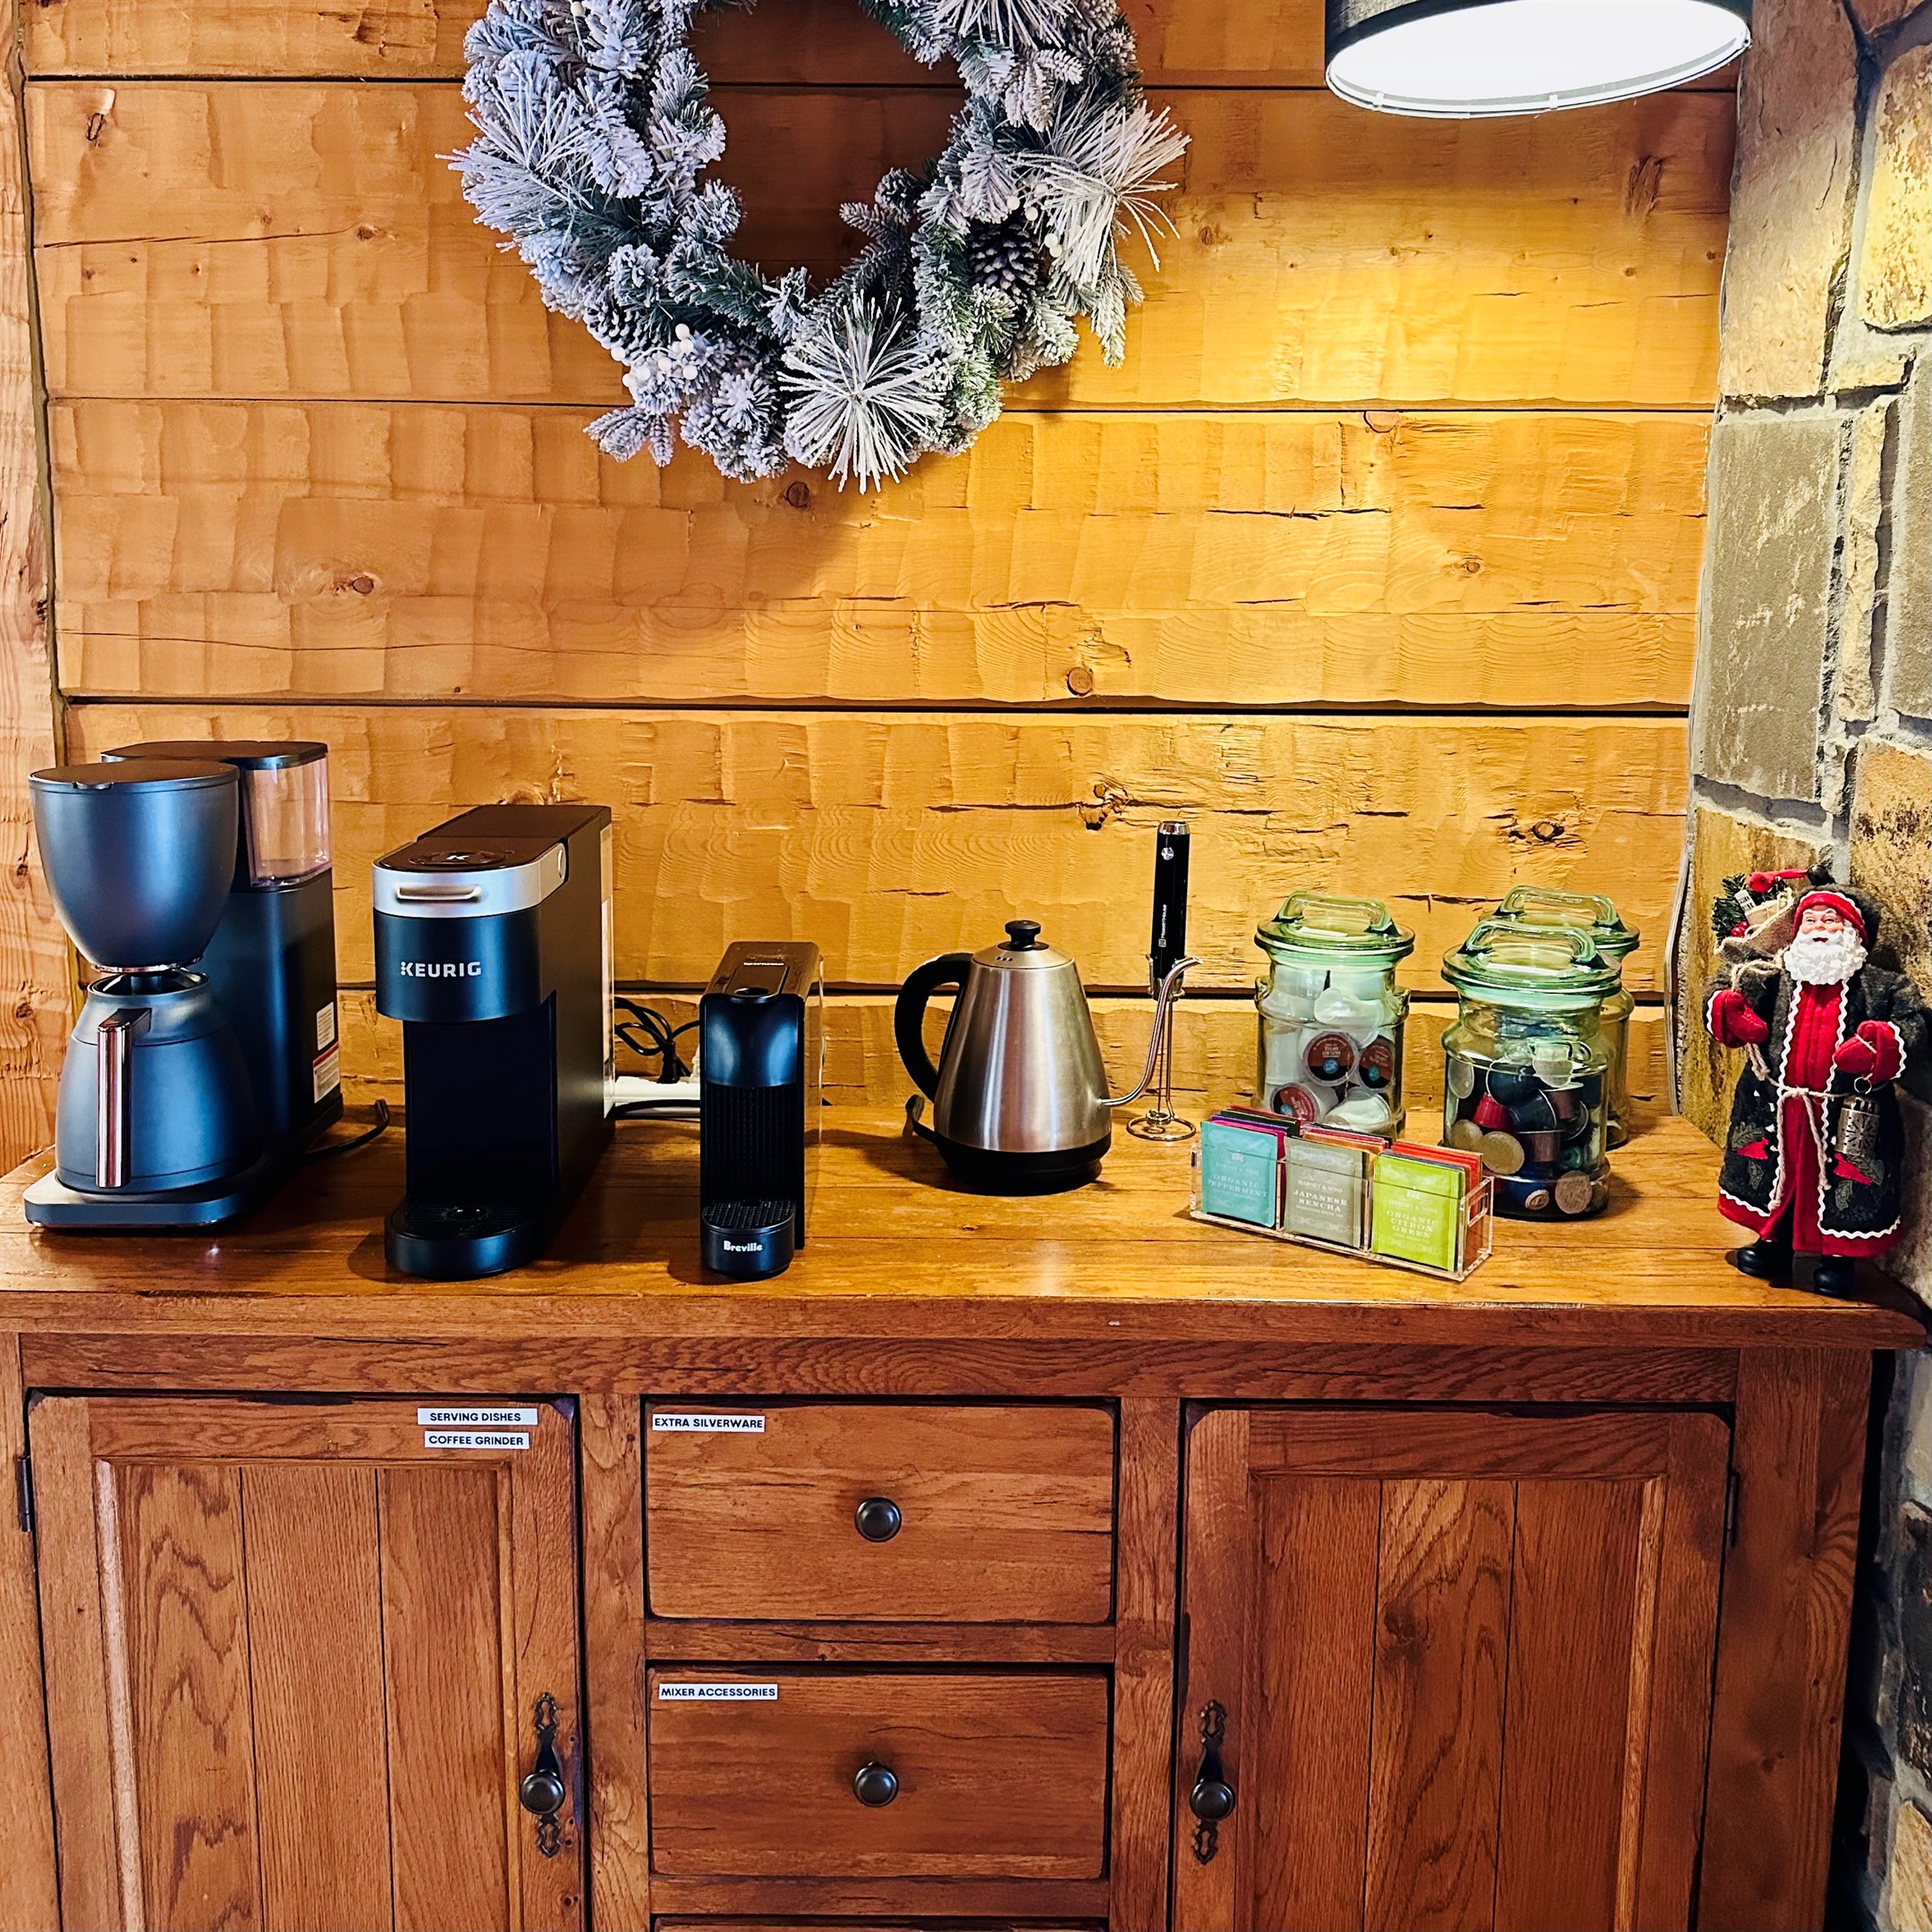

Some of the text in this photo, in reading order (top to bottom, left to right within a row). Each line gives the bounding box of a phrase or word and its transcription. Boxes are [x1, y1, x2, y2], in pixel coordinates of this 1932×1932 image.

[401, 961, 482, 978] KEURIG
[1208, 1180, 1268, 1197] PEPPERMINT
[1213, 1174, 1259, 1188] ORGANIC
[1293, 1190, 1347, 1206] JAPANESE
[1299, 1198, 1342, 1213] SENCHA
[1386, 1209, 1438, 1226] ORGANIC
[1390, 1217, 1434, 1233] CITRON
[1392, 1224, 1431, 1239] GREEN
[724, 1240, 763, 1252] Breville
[429, 1412, 521, 1421] SERVING DISHES
[655, 1418, 763, 1428] EXTRA SILVERWARE
[428, 1436, 524, 1445] COFFEE GRINDER
[661, 1688, 775, 1697] MIXER ACCESSORIES
